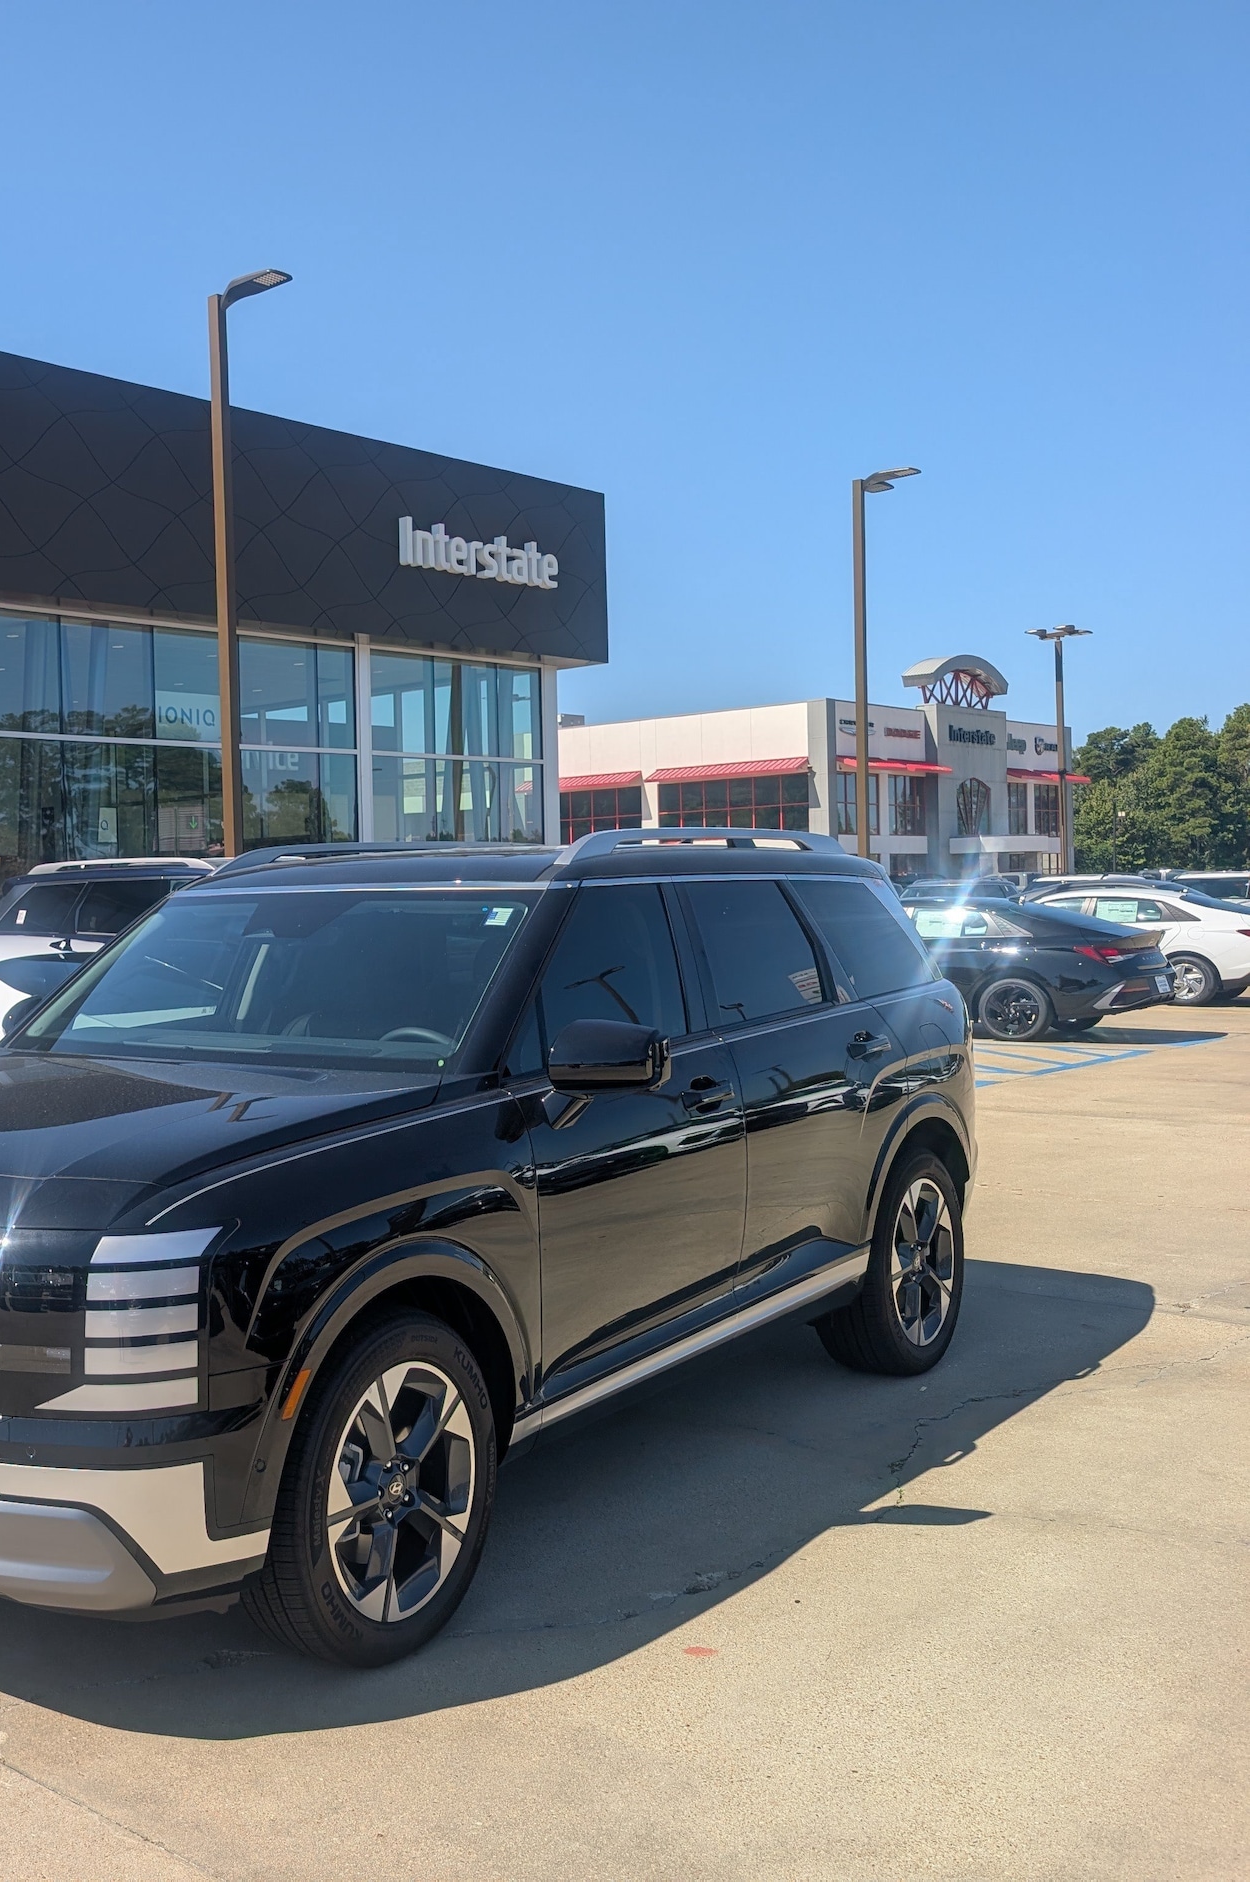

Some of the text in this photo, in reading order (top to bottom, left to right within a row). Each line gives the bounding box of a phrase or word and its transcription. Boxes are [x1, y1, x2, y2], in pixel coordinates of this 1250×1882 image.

[399, 516, 559, 589] Interstate
[158, 705, 216, 727] IONIQ
[948, 724, 997, 746] Interstate
[453, 1345, 489, 1410] KUMHO
[312, 1489, 324, 1547] Majesty
[320, 1580, 364, 1642] KUMHO
